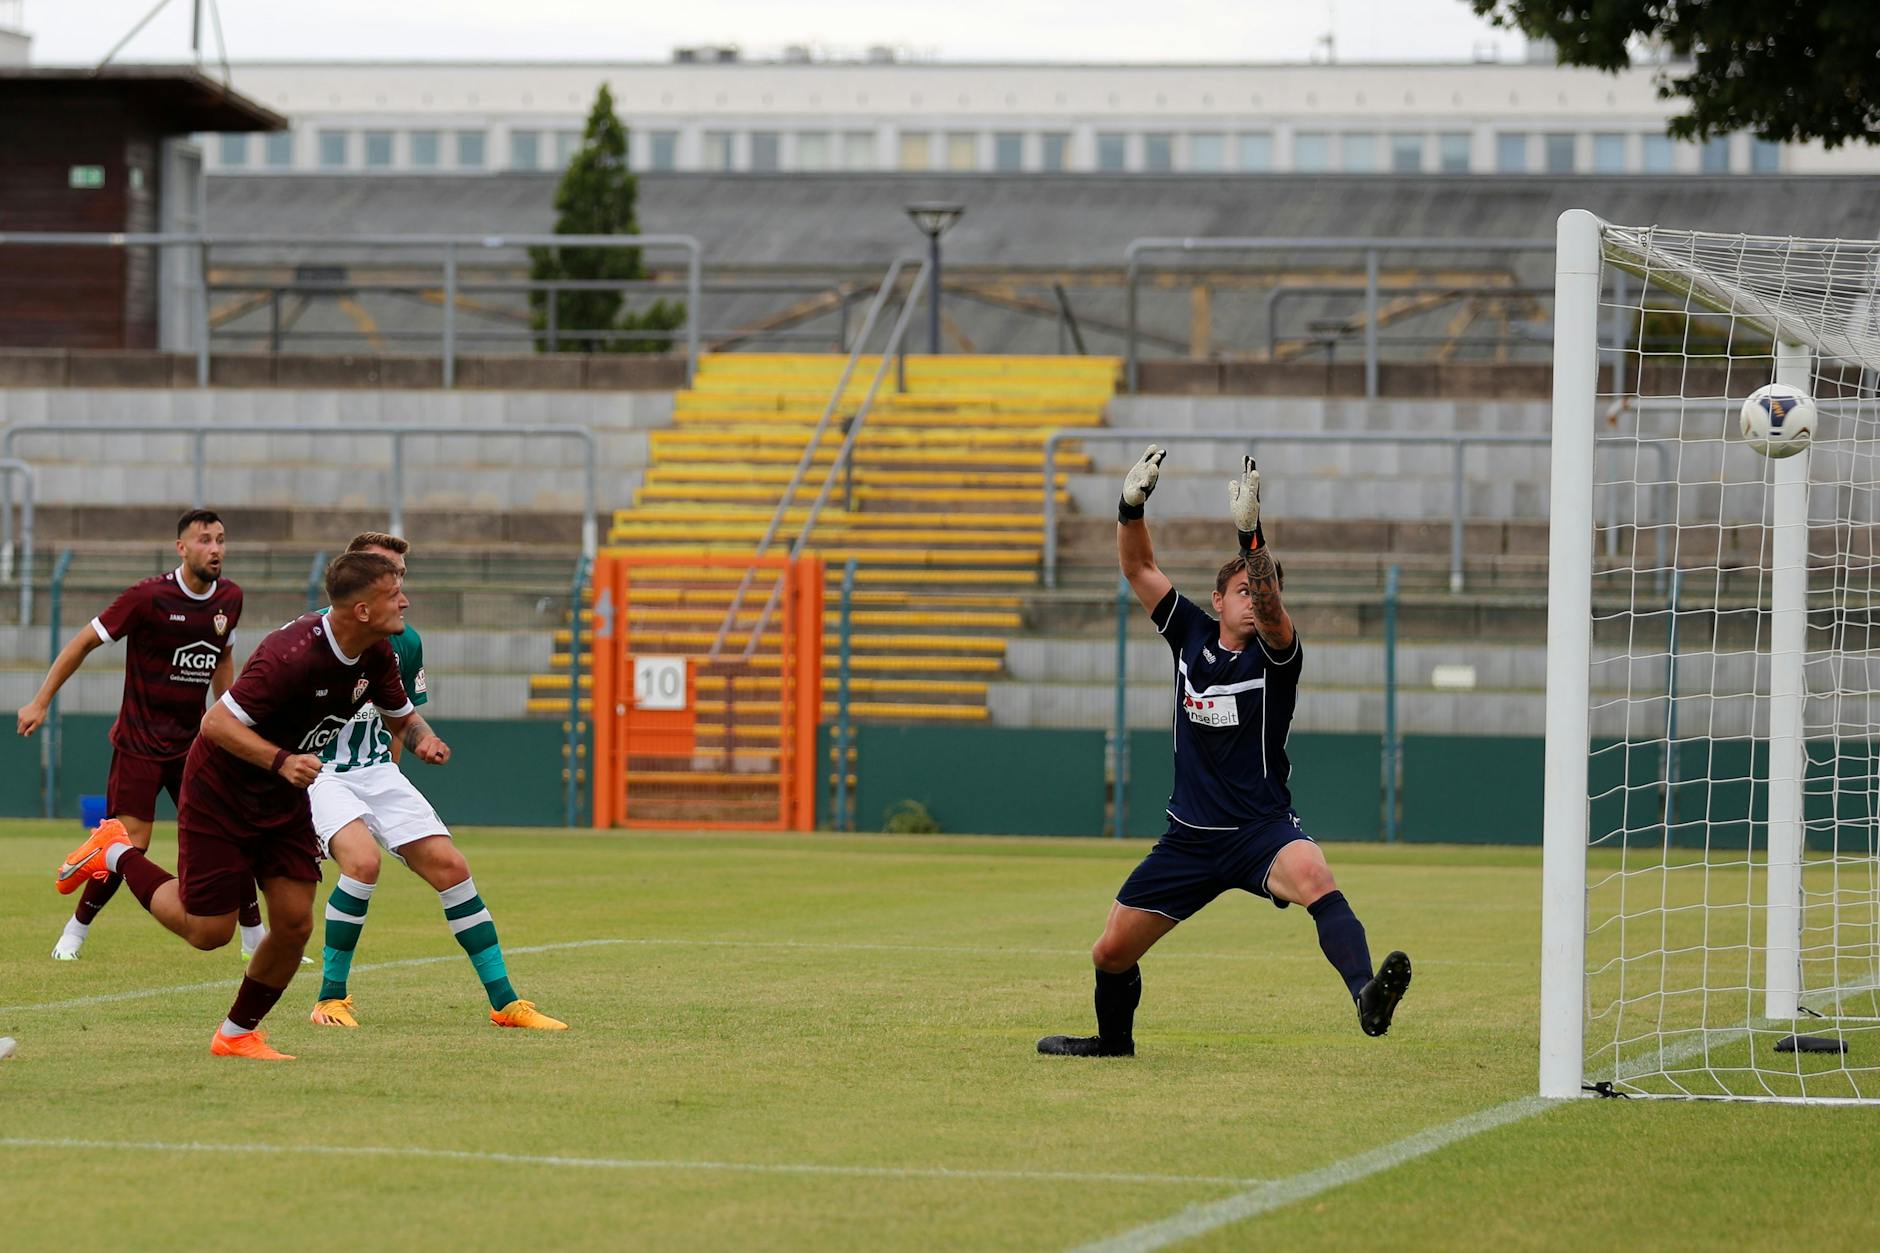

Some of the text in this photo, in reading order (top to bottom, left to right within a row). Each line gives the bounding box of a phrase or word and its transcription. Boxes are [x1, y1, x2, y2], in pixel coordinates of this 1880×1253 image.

[179, 652, 217, 669] KGR
[639, 666, 680, 700] 10
[1187, 711, 1238, 725] nseBelt
